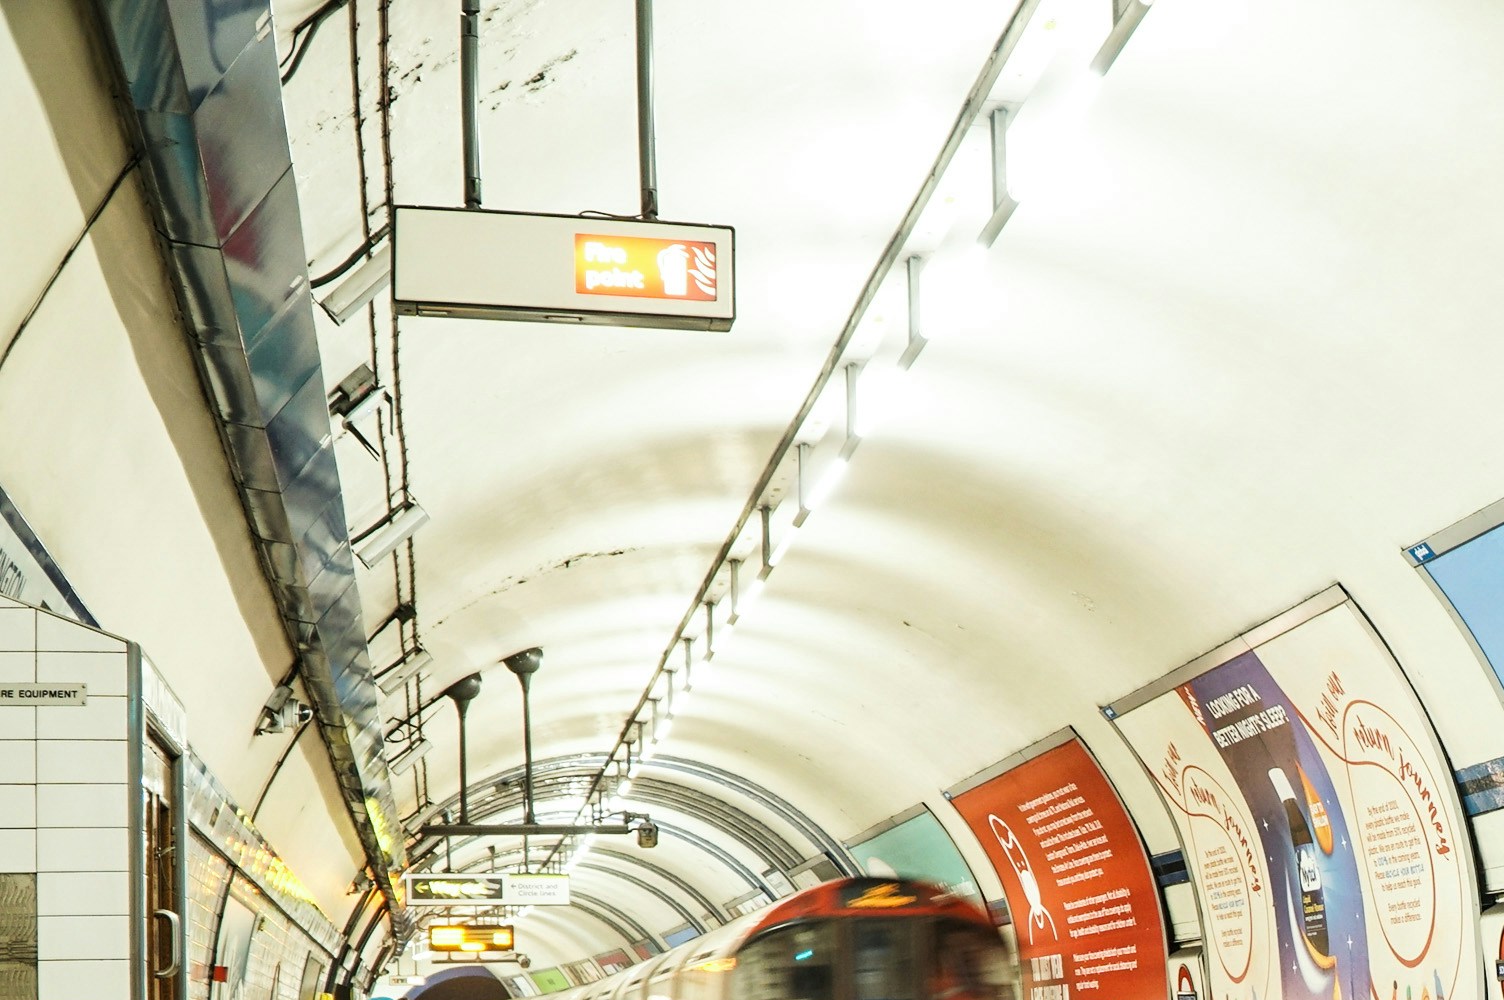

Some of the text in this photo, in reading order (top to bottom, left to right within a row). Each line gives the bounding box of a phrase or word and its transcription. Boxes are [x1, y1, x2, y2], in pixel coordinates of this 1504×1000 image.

[584, 241, 627, 264] Fire
[585, 268, 645, 290] point
[0, 690, 78, 699] RE EQUIPMENT
[1206, 691, 1239, 719] LOOKING
[1235, 686, 1252, 709] FOR
[1247, 683, 1261, 703] A
[1213, 720, 1241, 748] BETTER
[1261, 704, 1290, 730] SLEEP?
[1353, 714, 1451, 861] return journey
